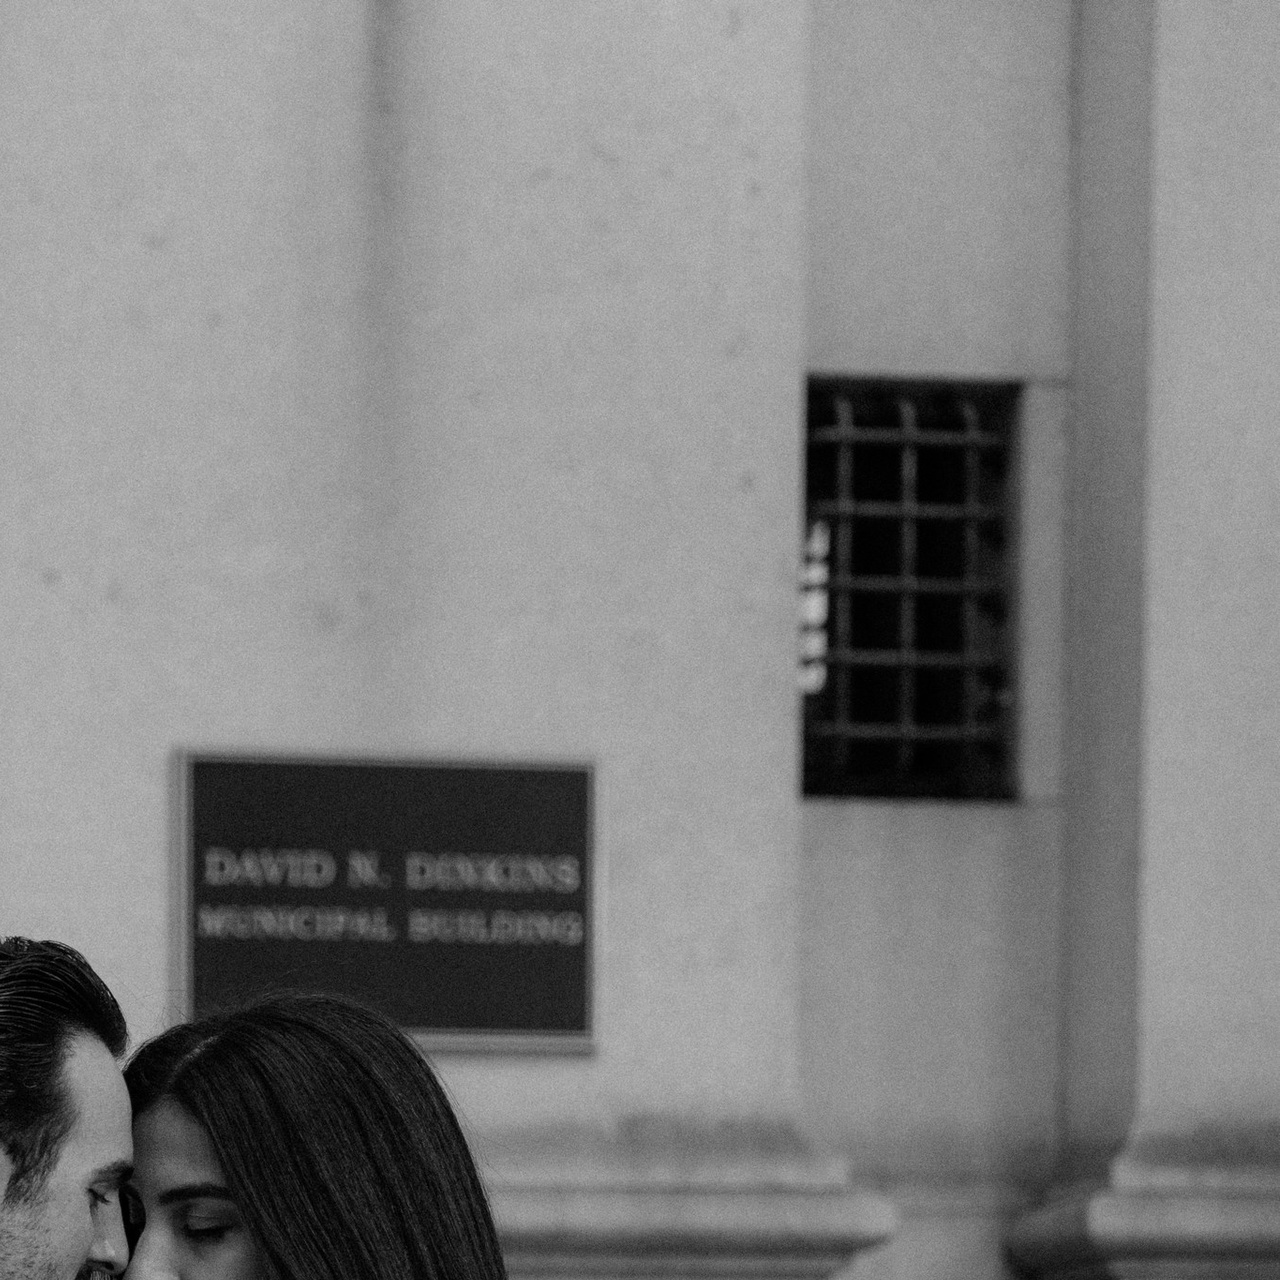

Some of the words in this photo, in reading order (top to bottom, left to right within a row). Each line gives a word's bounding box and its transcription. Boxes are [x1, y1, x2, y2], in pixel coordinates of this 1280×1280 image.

[204, 846, 337, 888] DAVID
[346, 849, 392, 890] N.
[405, 851, 581, 894] DINKINS
[197, 903, 397, 942] MUNICIPAL
[407, 907, 583, 946] BUILDING
